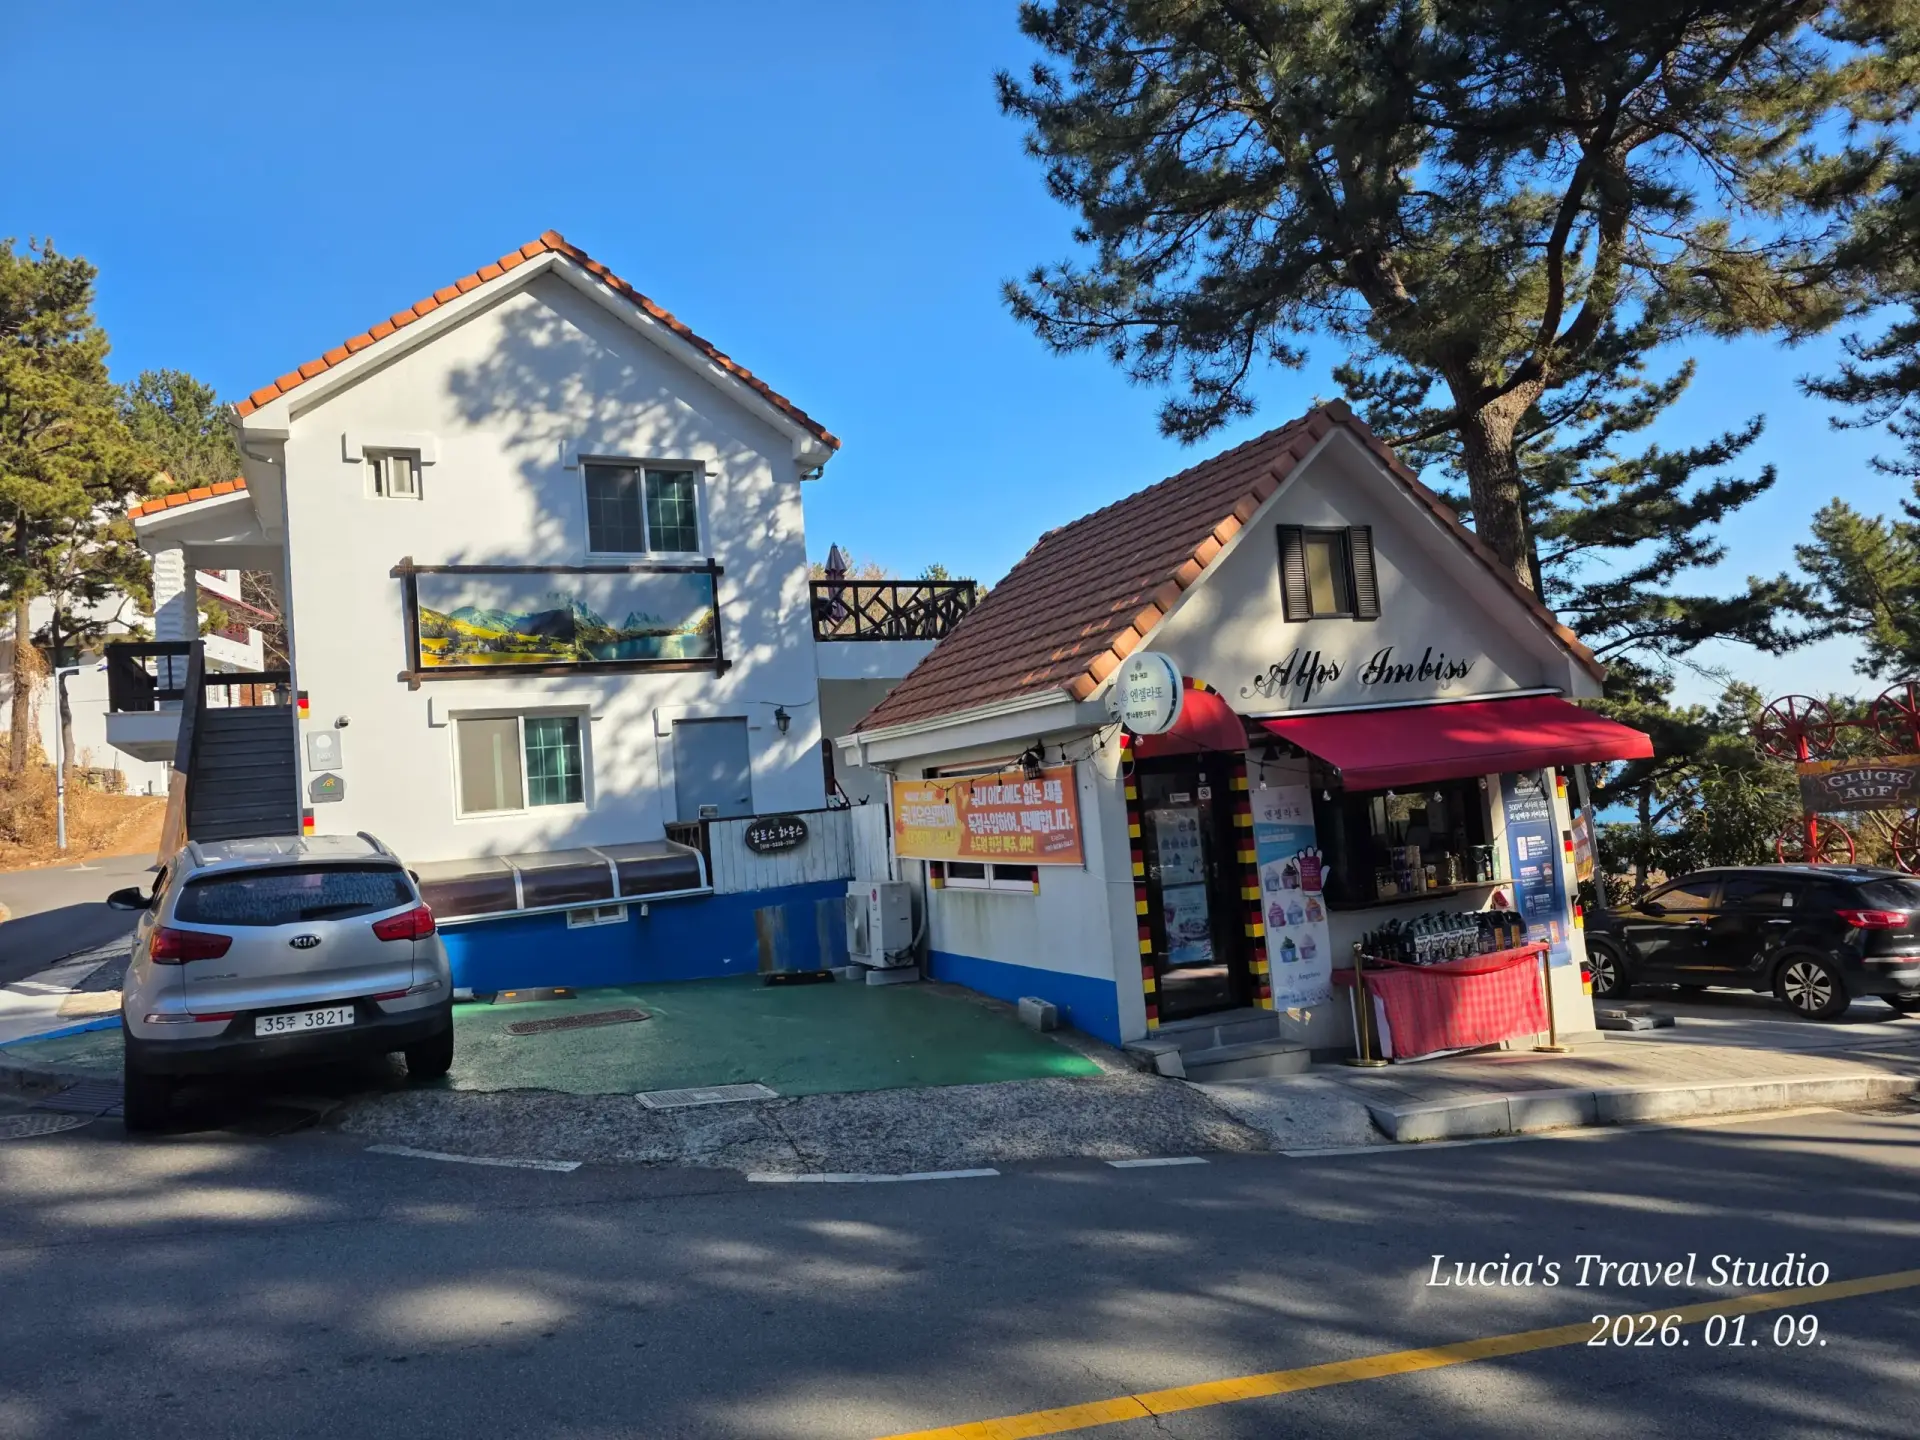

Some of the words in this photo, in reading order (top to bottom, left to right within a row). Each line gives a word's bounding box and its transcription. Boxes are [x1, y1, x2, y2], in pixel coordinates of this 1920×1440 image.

[1254, 648, 1346, 702] Alps
[1362, 646, 1475, 685] Imbiss
[1129, 686, 1163, 703] 엔젤라또
[1828, 770, 1907, 788] GLÜCK
[971, 785, 987, 808] 국내
[988, 783, 1022, 805] 어디에도
[1023, 782, 1042, 805] 없는
[1845, 785, 1892, 799] AUF
[1020, 808, 1074, 833] 판매합니다.
[751, 829, 775, 844] 알프스
[779, 825, 803, 838] 하우스
[1019, 836, 1034, 853] 와인
[293, 936, 317, 948] KIA
[264, 1015, 297, 1032] 35주
[304, 1009, 346, 1027] 3821
